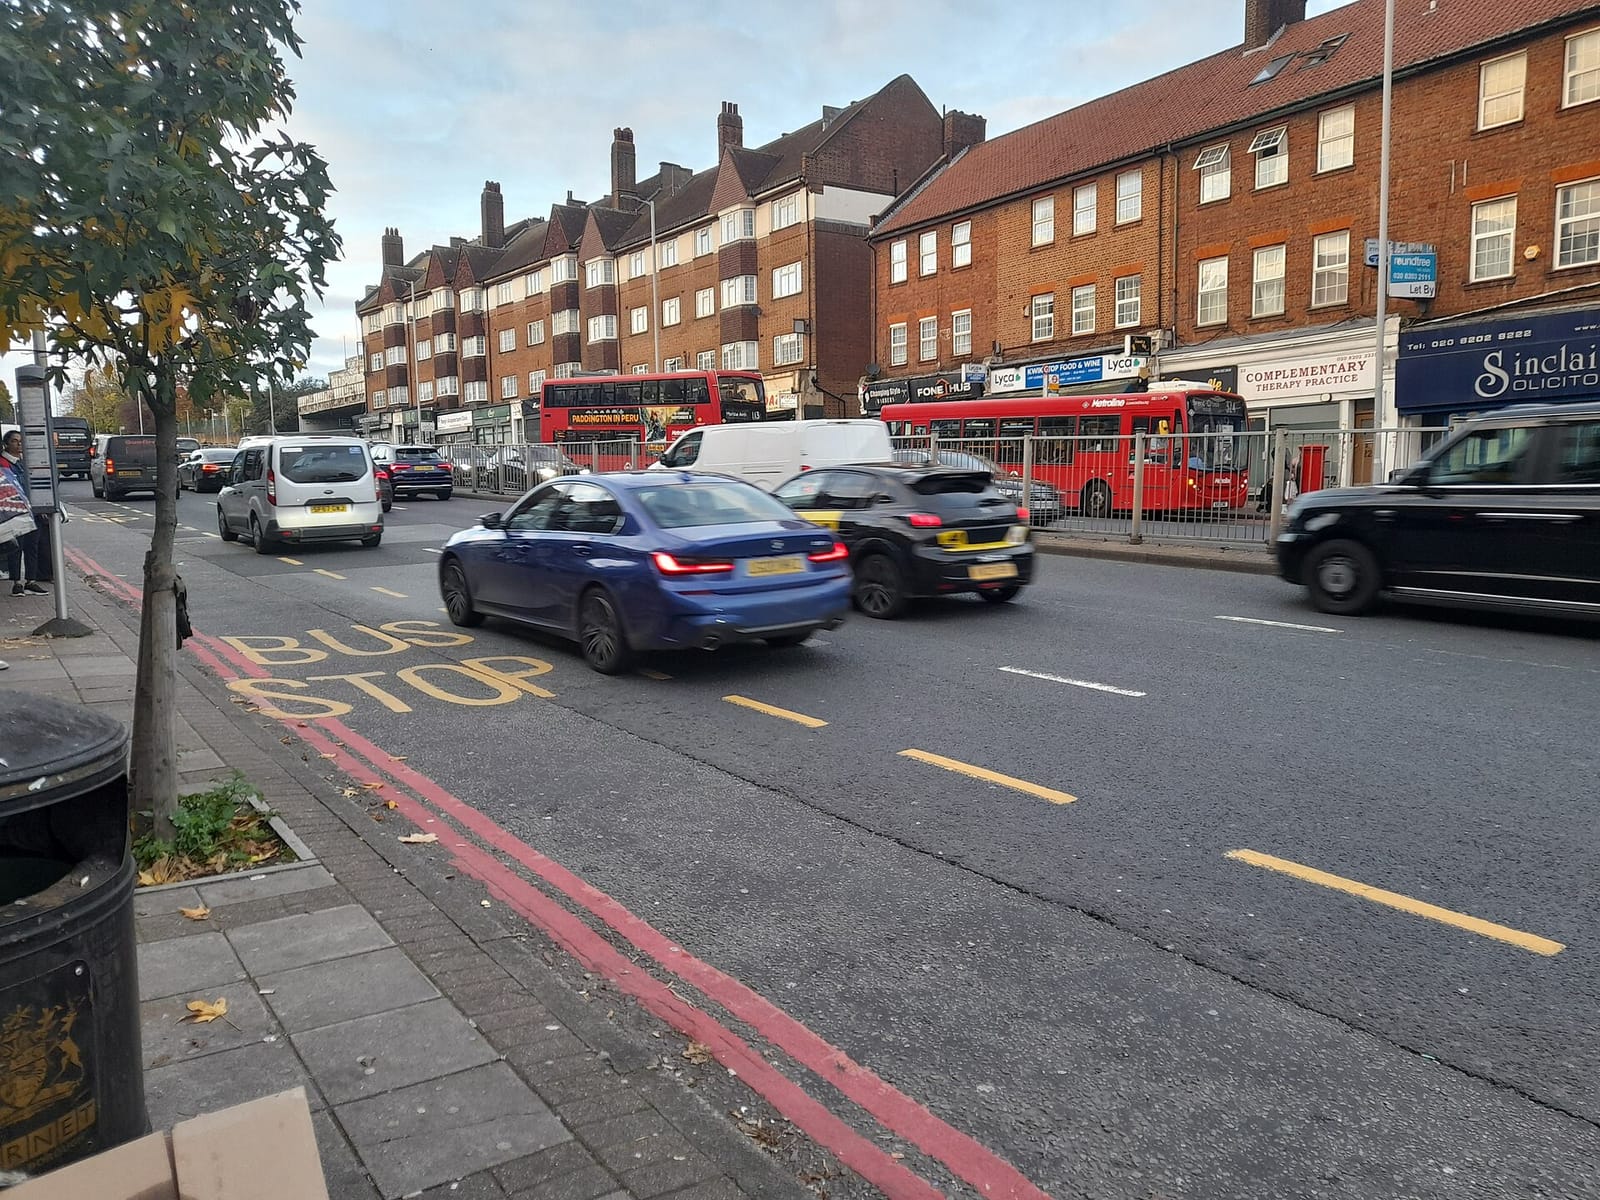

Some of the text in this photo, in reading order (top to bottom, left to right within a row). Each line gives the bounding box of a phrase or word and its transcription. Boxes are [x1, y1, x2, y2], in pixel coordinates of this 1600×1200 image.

[1409, 284, 1434, 296] Let By
[1407, 343, 1426, 351] Tel:
[1431, 338, 1454, 348] 020
[1460, 334, 1492, 344] 8202
[1027, 366, 1044, 376] KWIK
[1060, 363, 1077, 371] FOOD
[1083, 359, 1100, 368] WINE
[1107, 358, 1132, 371] Lyca
[1246, 360, 1367, 383] COMPLEMENTARY
[995, 374, 1015, 386] Lyca
[1256, 373, 1359, 392] THERAPY PRACTICE
[917, 382, 971, 397] FONE HUB
[1091, 398, 1126, 408] Metroline
[572, 413, 639, 423] PADDINGTON IN PERU
[219, 620, 475, 665] BUS
[226, 655, 556, 719] STOP
